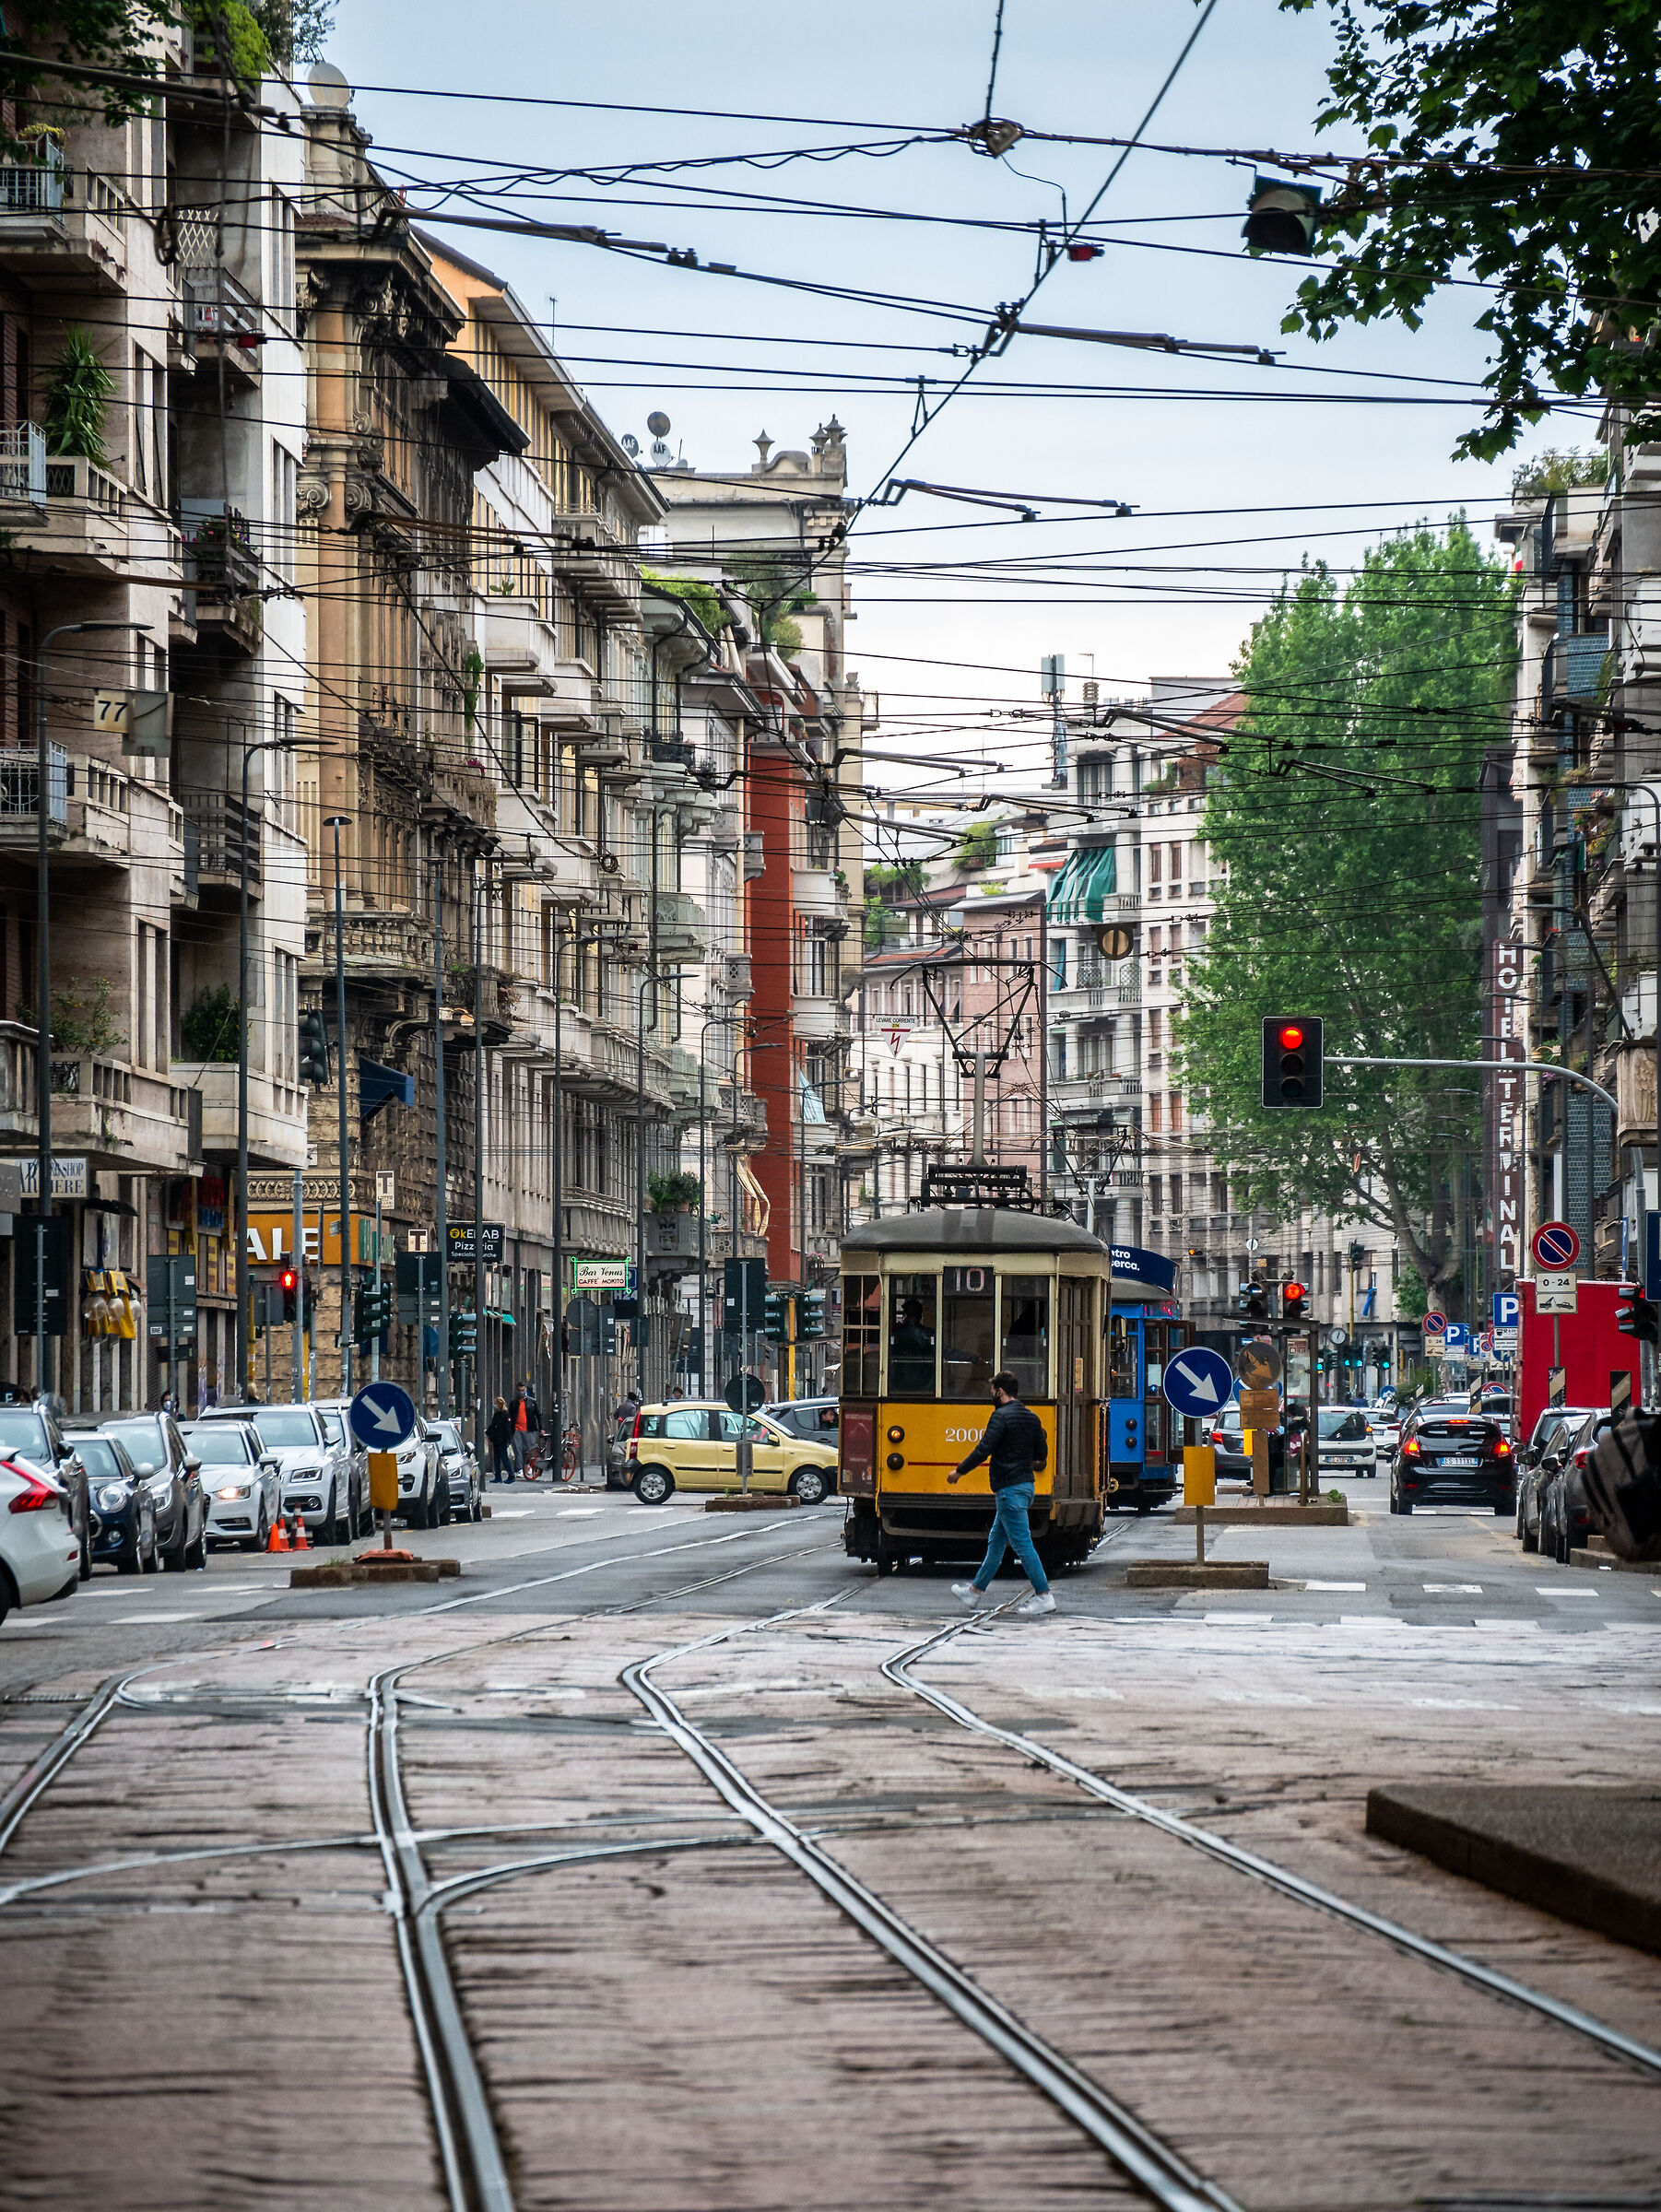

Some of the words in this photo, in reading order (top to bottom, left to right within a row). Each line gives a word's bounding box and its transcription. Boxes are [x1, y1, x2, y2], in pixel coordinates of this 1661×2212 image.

[654, 444, 666, 454] AAF
[98, 700, 128, 722] 77
[1498, 1077, 1517, 1271] TERMINAL
[454, 1241, 494, 1251] Pizzia
[579, 1266, 597, 1277] Bar
[601, 1266, 623, 1277] Venus
[954, 1267, 984, 1292] 10
[1543, 1278, 1549, 1287] 0
[1557, 1278, 1570, 1287] 24
[1501, 1297, 1519, 1323] P
[1446, 1326, 1460, 1343] P
